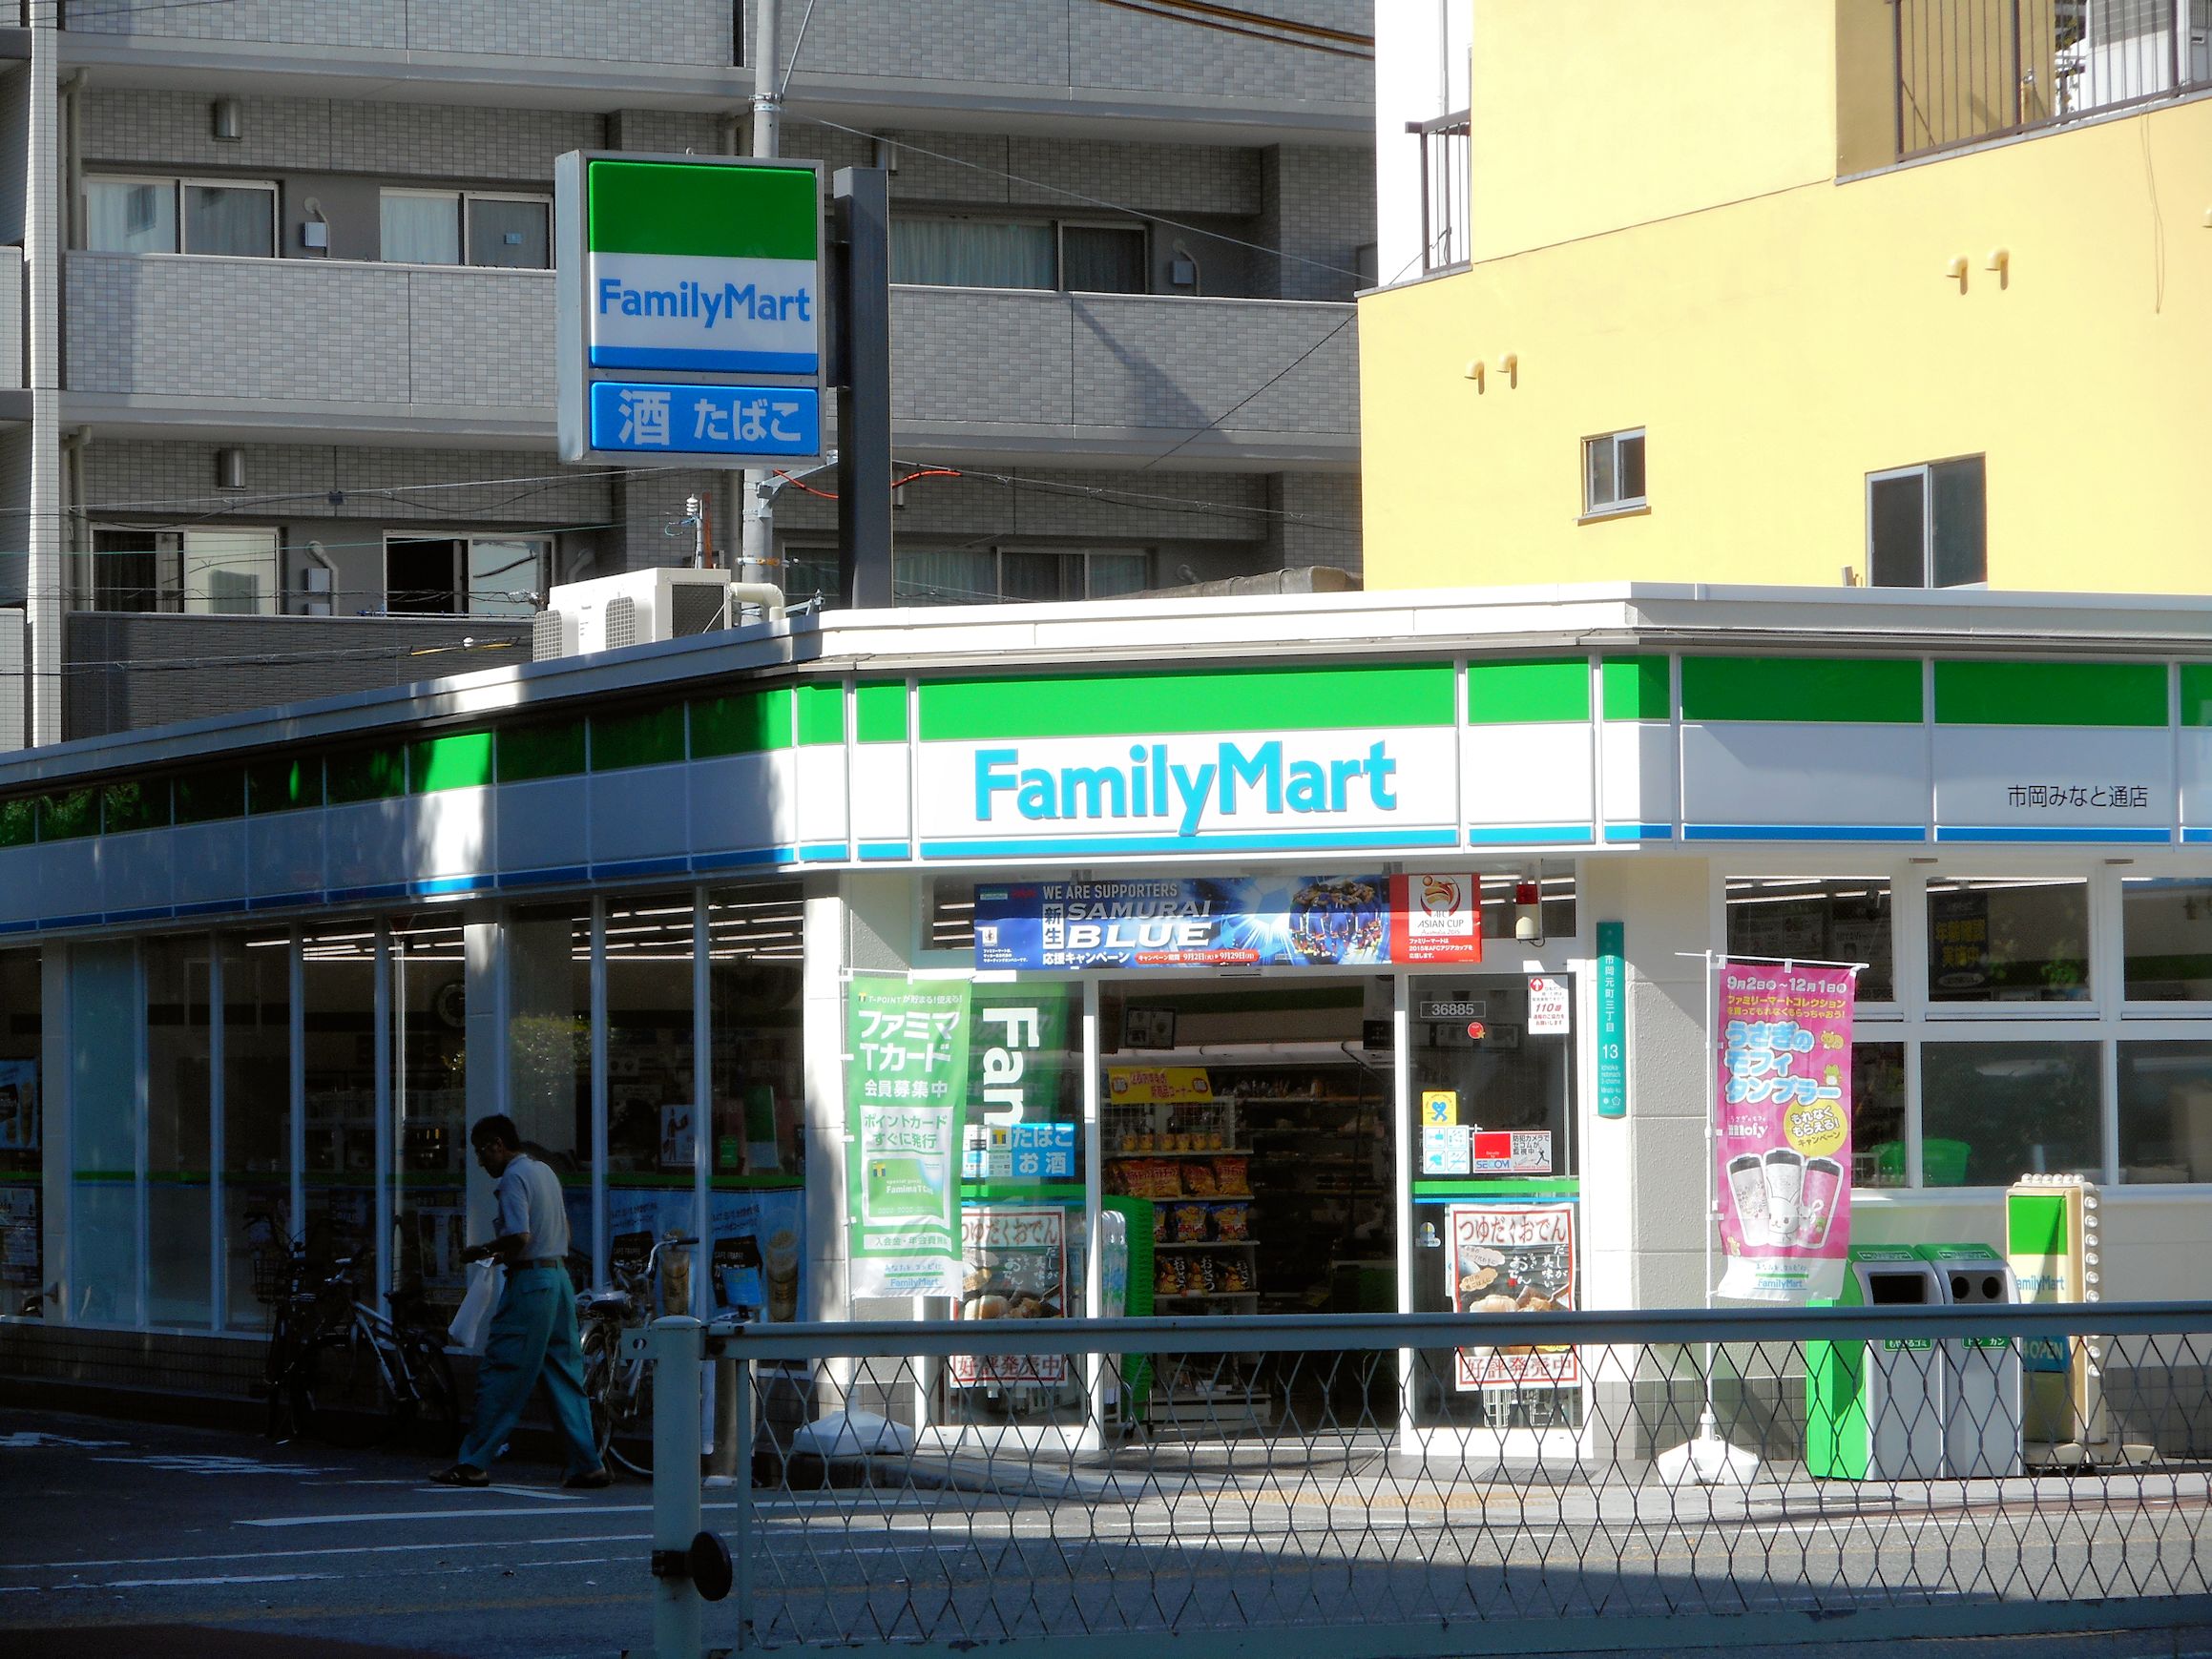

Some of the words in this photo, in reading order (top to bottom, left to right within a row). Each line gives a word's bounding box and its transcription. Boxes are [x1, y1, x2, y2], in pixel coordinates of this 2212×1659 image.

[599, 279, 810, 328] FamilyMart
[618, 389, 671, 446] 酒
[695, 398, 801, 441] たばこ
[975, 740, 1397, 837] FamilyMart
[2008, 784, 2148, 808] 市岡みなと通店
[1043, 885, 1062, 900] WE
[1066, 885, 1090, 899] ARE
[1095, 882, 1178, 898] SUPPORTERS
[1068, 900, 1211, 921] SAMURAI
[1044, 906, 1062, 946] 新生
[1066, 922, 1212, 949] BLUE
[1042, 952, 1130, 964] 応援キャンペーン
[1605, 955, 1616, 1033] 市岡元町三丁目
[1728, 995, 1847, 1008] ファミリーマートコレクション
[1431, 1004, 1474, 1016] 36885
[859, 1010, 960, 1040] ファミマ
[1726, 1022, 1814, 1052] うさぎの
[860, 1043, 950, 1073] Tカード
[1602, 1044, 1618, 1059] 13
[1725, 1050, 1792, 1077] モフィ
[865, 1079, 948, 1098] 会員募集中
[1726, 1077, 1841, 1106] タンブラー
[865, 1114, 948, 1130] ポイントカード
[1791, 1107, 1833, 1124] もれなく
[874, 1132, 937, 1149] すぐに発行
[1012, 1126, 1073, 1148] たばこ
[1798, 1131, 1841, 1147] キャンペーン
[1019, 1152, 1067, 1174] お酒
[1476, 1159, 1510, 1169] SECOM
[1458, 1215, 1566, 1244] つゆだくおでん
[890, 1277, 938, 1289] FamilyMart
[1759, 1279, 1803, 1289] FamilyMart
[2016, 1275, 2064, 1295] amilyMart
[1889, 1339, 1927, 1348] もやるゴミ
[1466, 1356, 1571, 1379] 好評発売中
